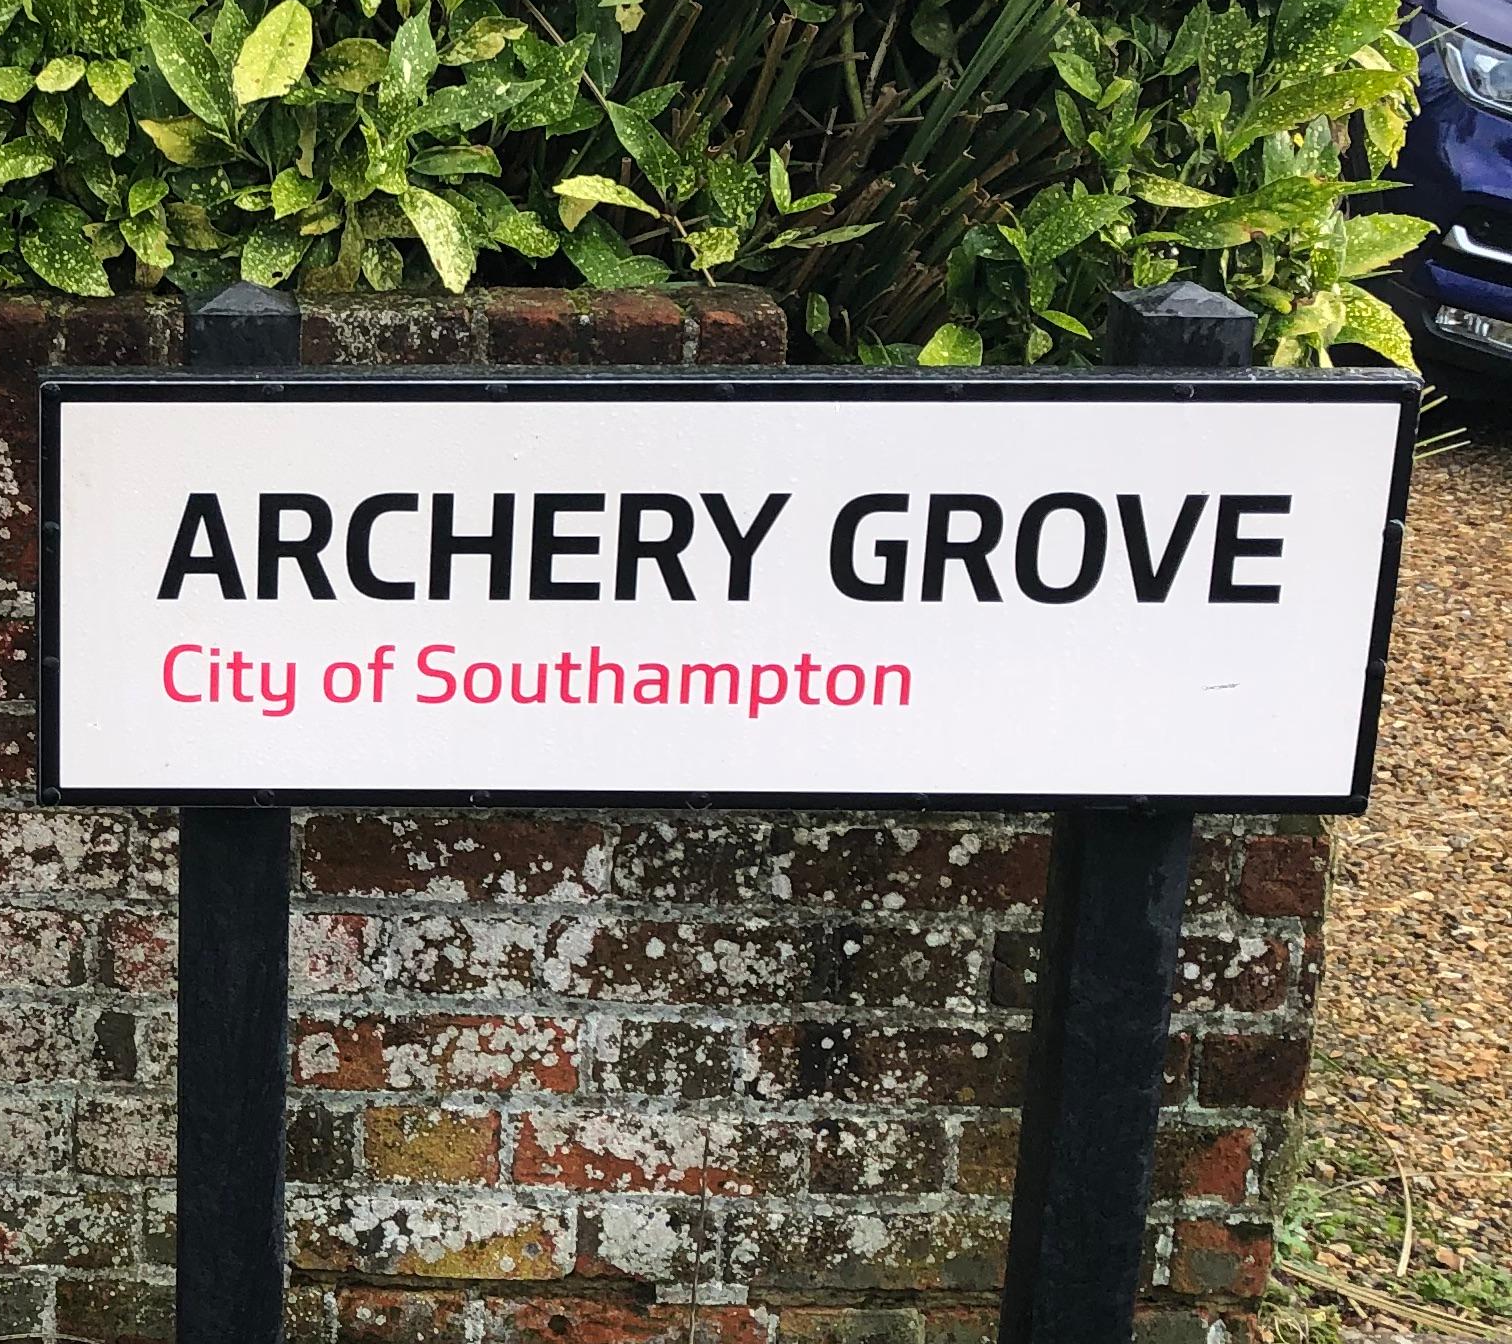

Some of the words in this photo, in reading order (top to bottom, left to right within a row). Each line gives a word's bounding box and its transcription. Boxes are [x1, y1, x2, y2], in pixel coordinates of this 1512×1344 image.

[156, 492, 791, 601] ARCHERY
[828, 492, 1291, 604] GROVE
[162, 643, 296, 717] City
[322, 644, 396, 703] of
[415, 644, 912, 718] Southampton
